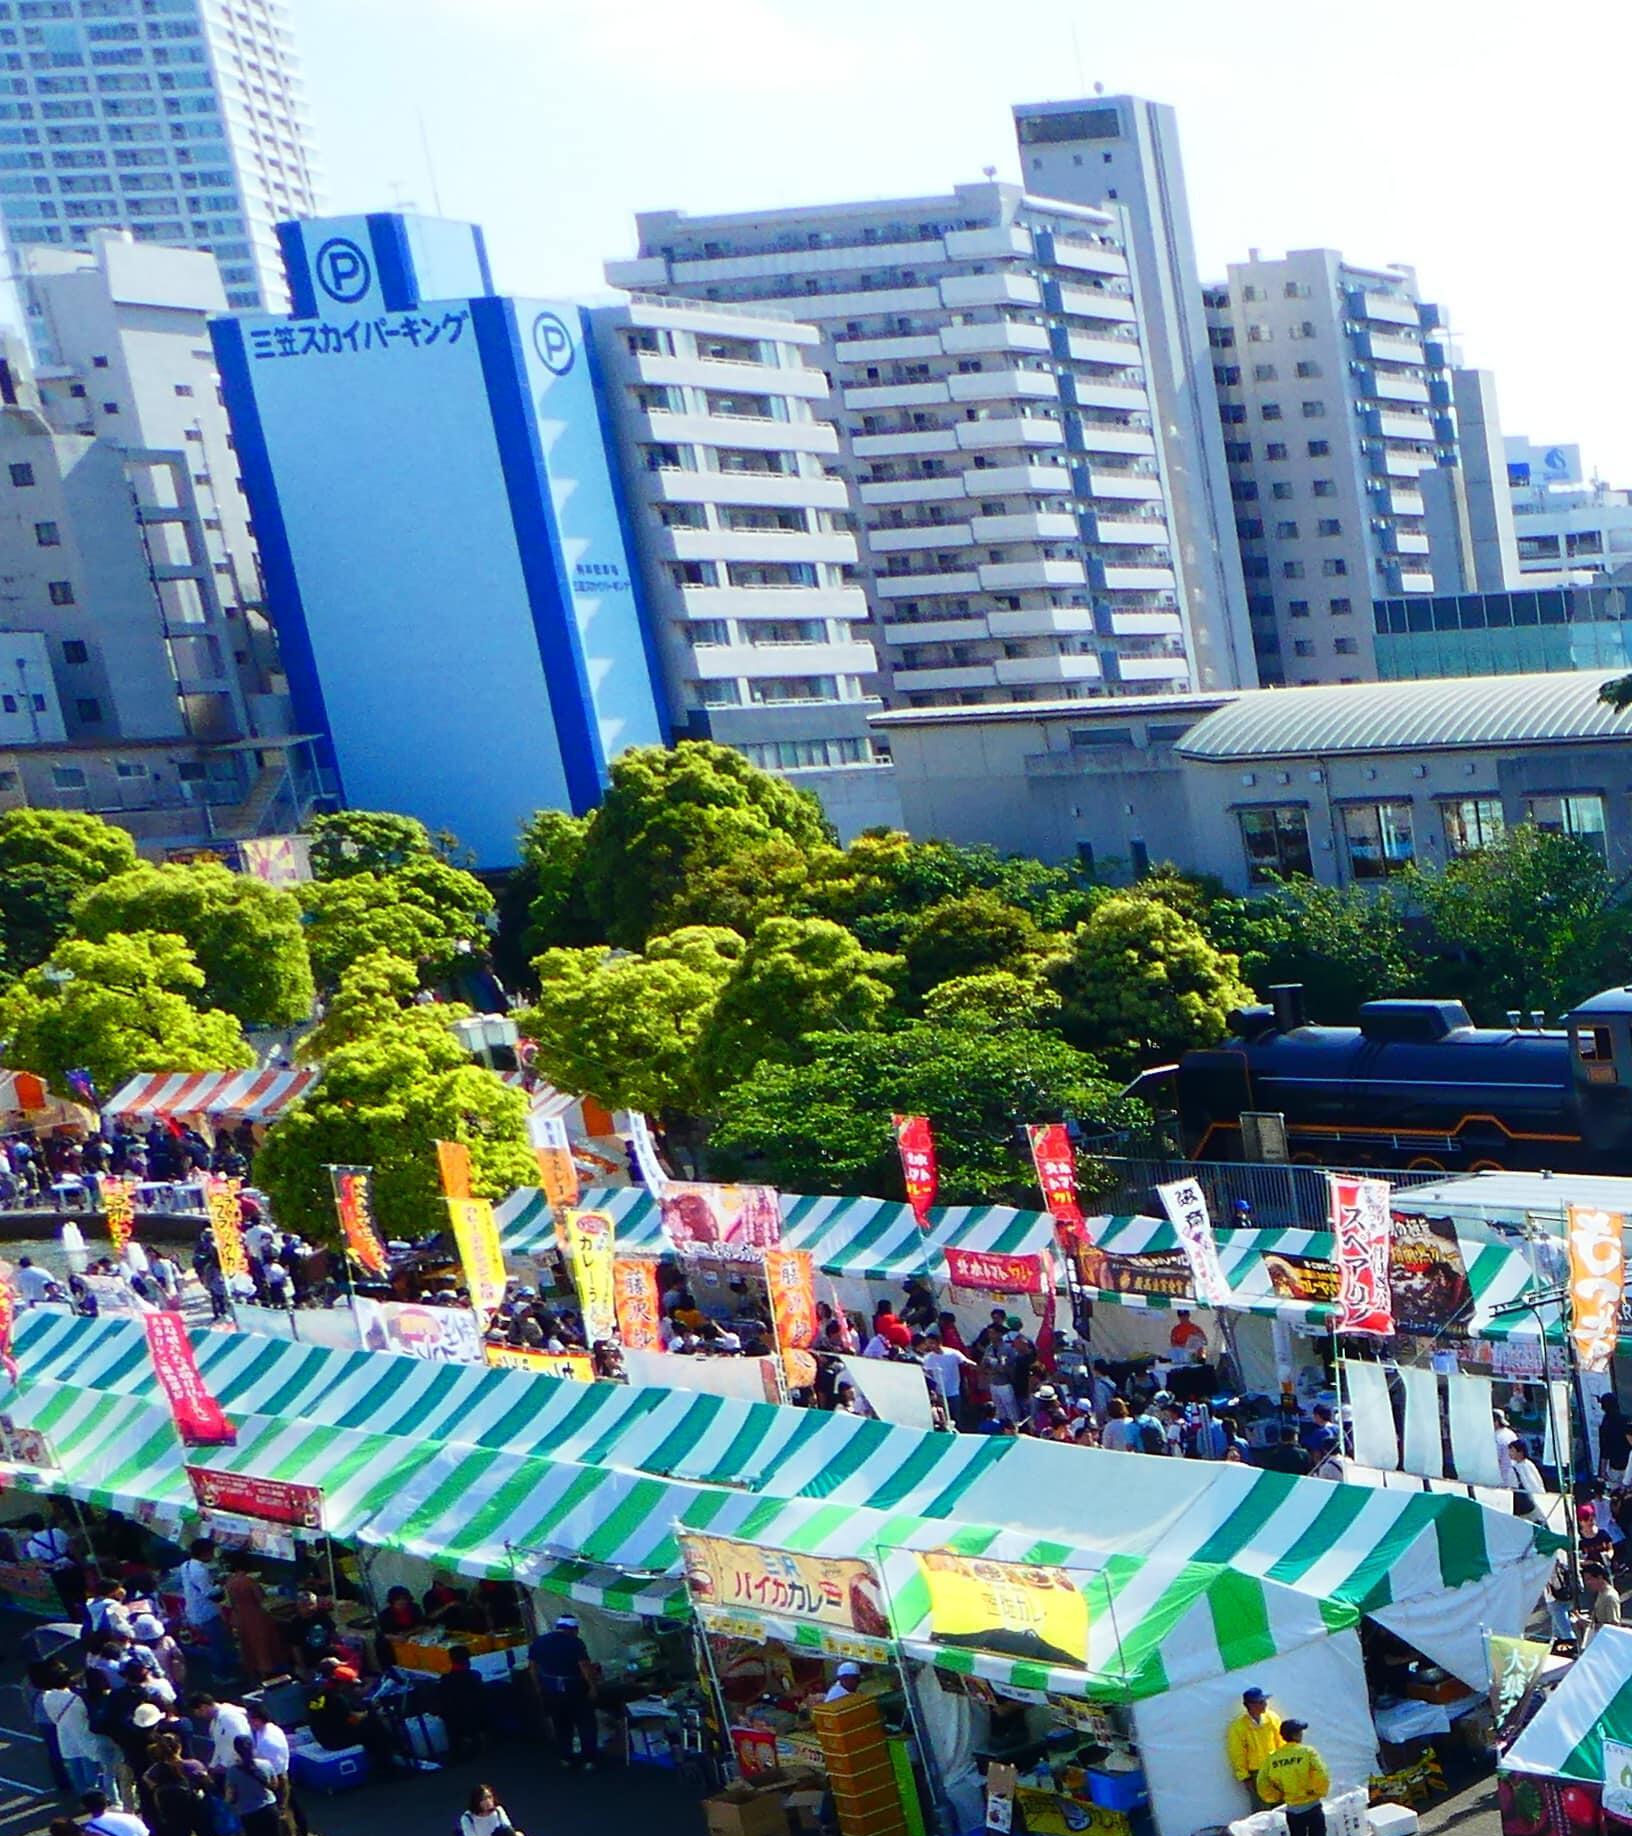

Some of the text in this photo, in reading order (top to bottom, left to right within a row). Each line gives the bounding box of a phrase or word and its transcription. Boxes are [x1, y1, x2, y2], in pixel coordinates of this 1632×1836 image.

[250, 310, 469, 360] 三笠スカイパーキング
[1272, 1757, 1304, 1769] STAFF
